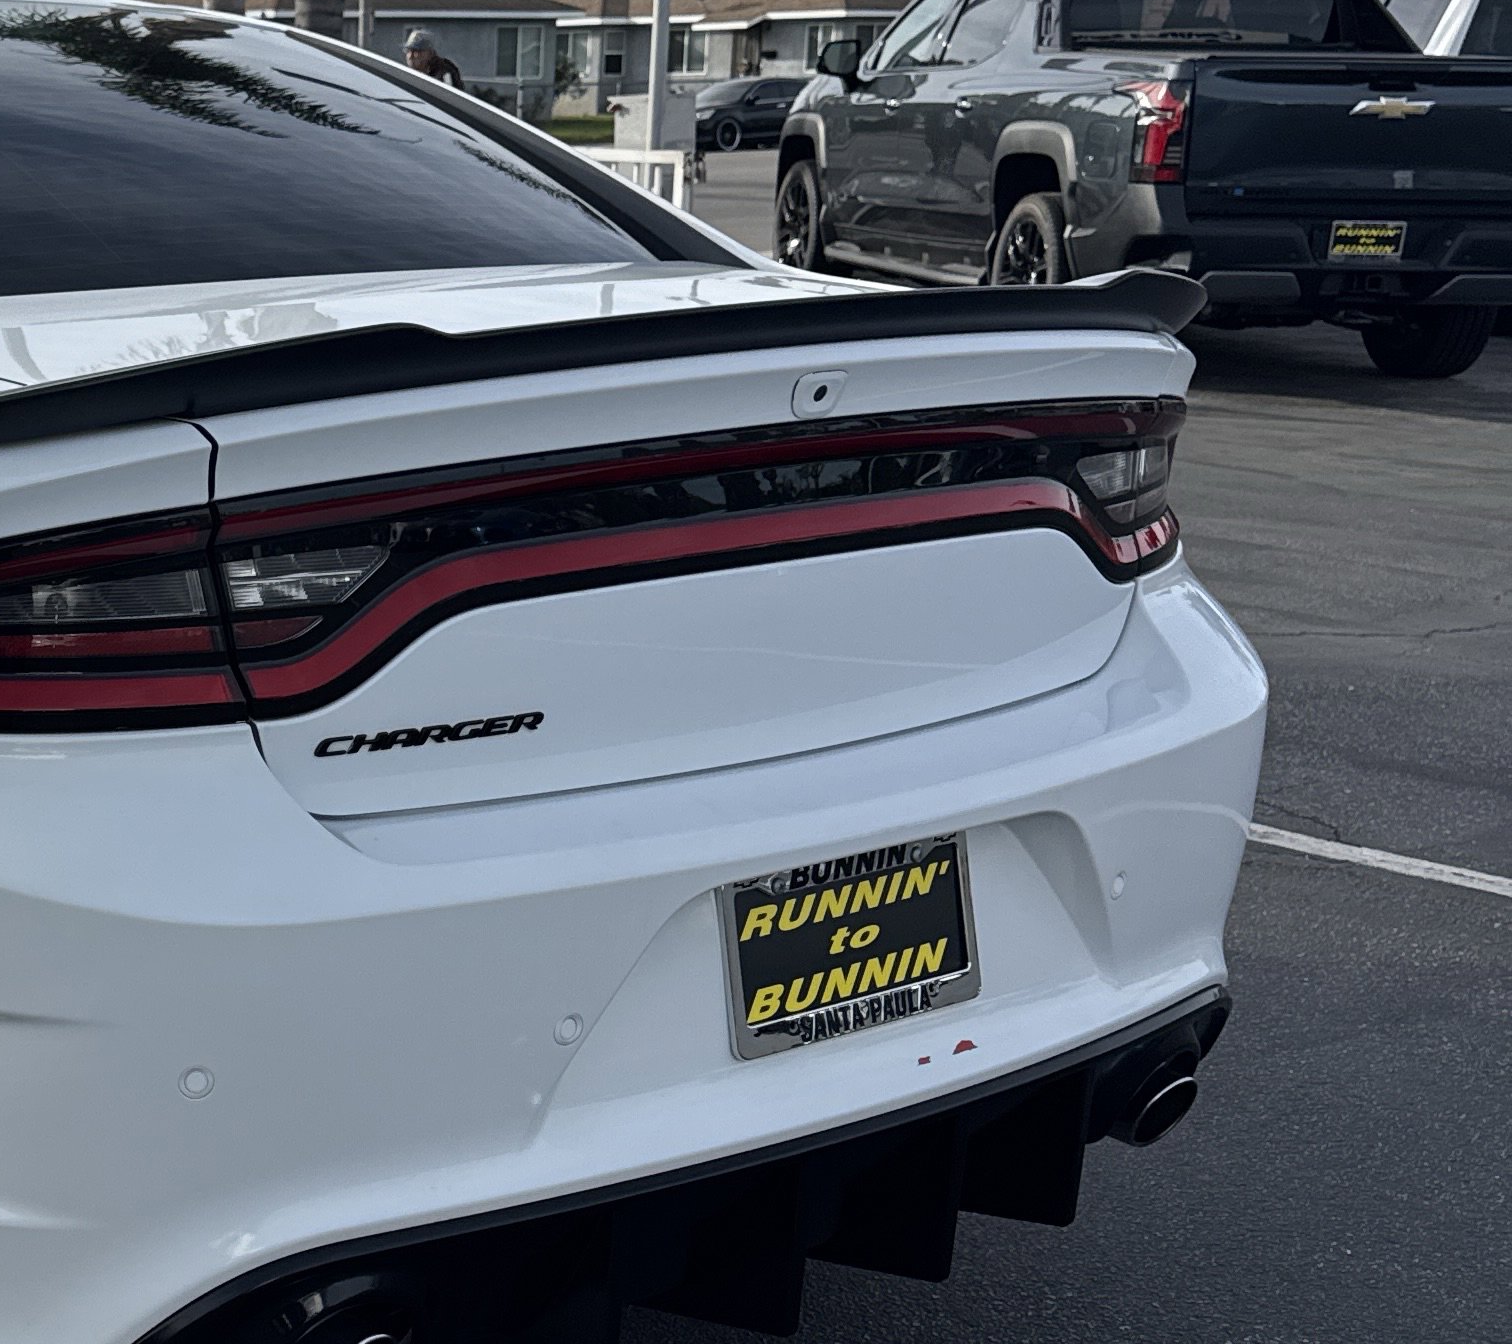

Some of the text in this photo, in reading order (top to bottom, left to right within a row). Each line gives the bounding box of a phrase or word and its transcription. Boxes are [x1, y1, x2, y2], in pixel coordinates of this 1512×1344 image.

[314, 711, 544, 757] CHARGER
[789, 843, 907, 890] BUNNIN
[739, 859, 951, 943] RUNNIN'
[829, 924, 881, 955] to
[746, 937, 949, 1025] BUNNIN
[800, 982, 933, 1044] SANTA PAULA
